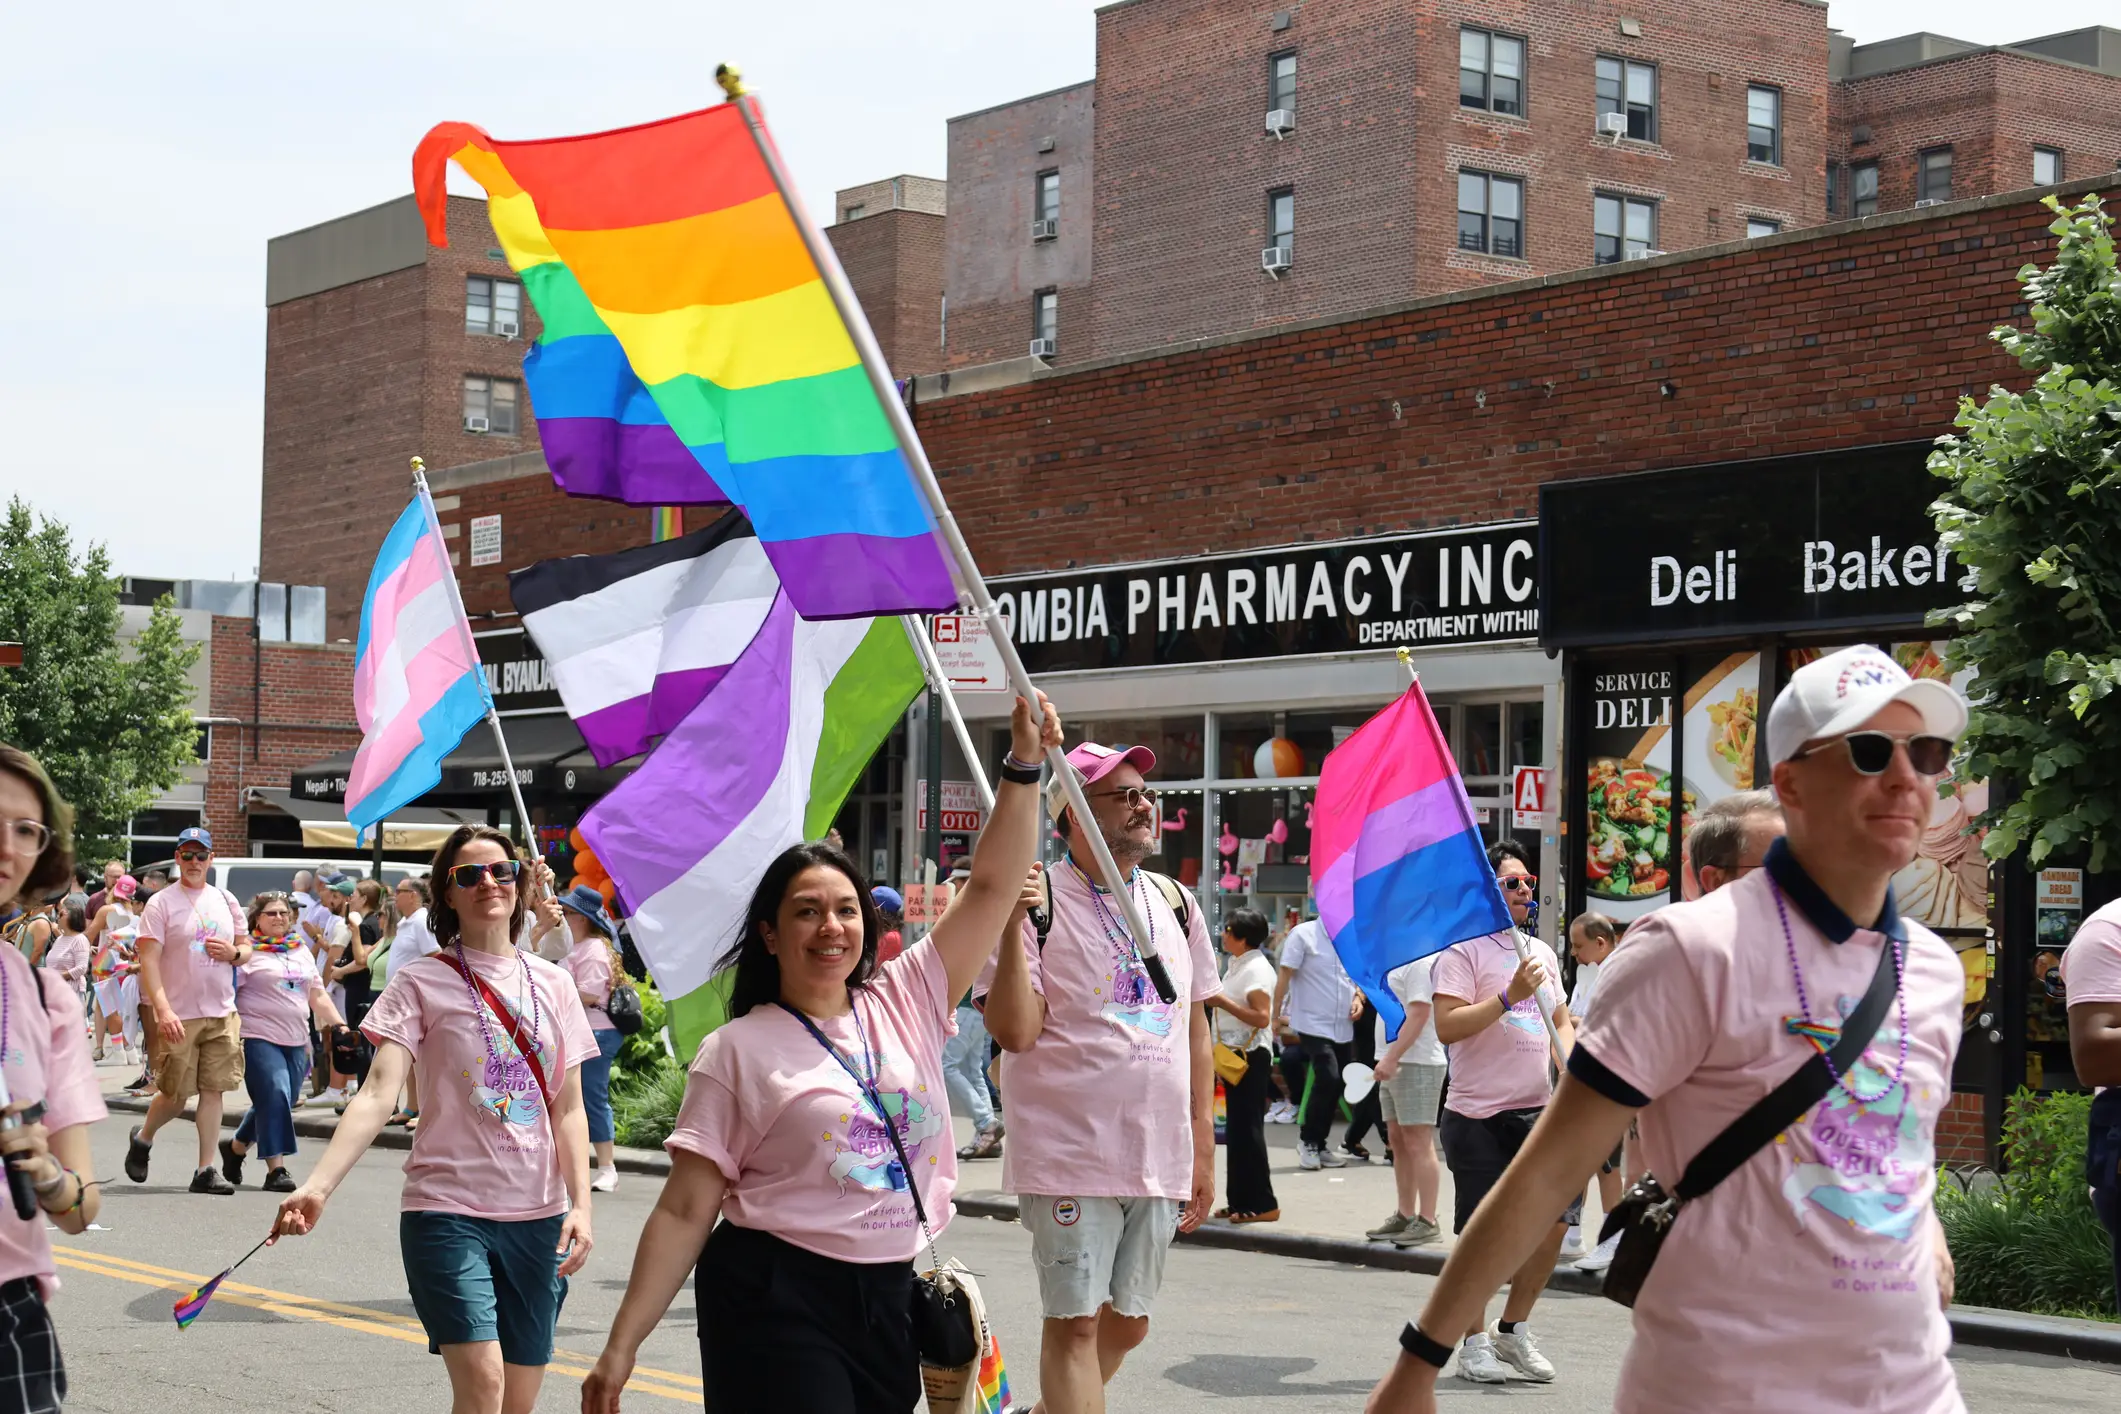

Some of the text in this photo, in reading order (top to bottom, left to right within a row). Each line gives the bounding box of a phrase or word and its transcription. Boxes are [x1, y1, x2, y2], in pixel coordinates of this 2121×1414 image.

[1651, 535, 1976, 606] Deli Baker
[996, 539, 1538, 644] OMBIA PHARMACY INC
[1359, 614, 1478, 644] DEPARTMENT
[962, 636, 977, 644] Only
[941, 660, 960, 668] xcept
[503, 659, 557, 695] BYANJA
[1595, 672, 1671, 692] SERVICE
[1595, 697, 1672, 729] DELI
[305, 778, 347, 796] Nepali Tib
[473, 769, 533, 787] 718-255-080
[943, 837, 962, 845] John
[910, 907, 945, 917] SUNAY
[852, 1124, 910, 1138] QUEES
[506, 1145, 520, 1153] our
[859, 1137, 909, 1155] PRIE
[881, 1205, 906, 1217] future
[860, 1216, 913, 1231] in our hands
